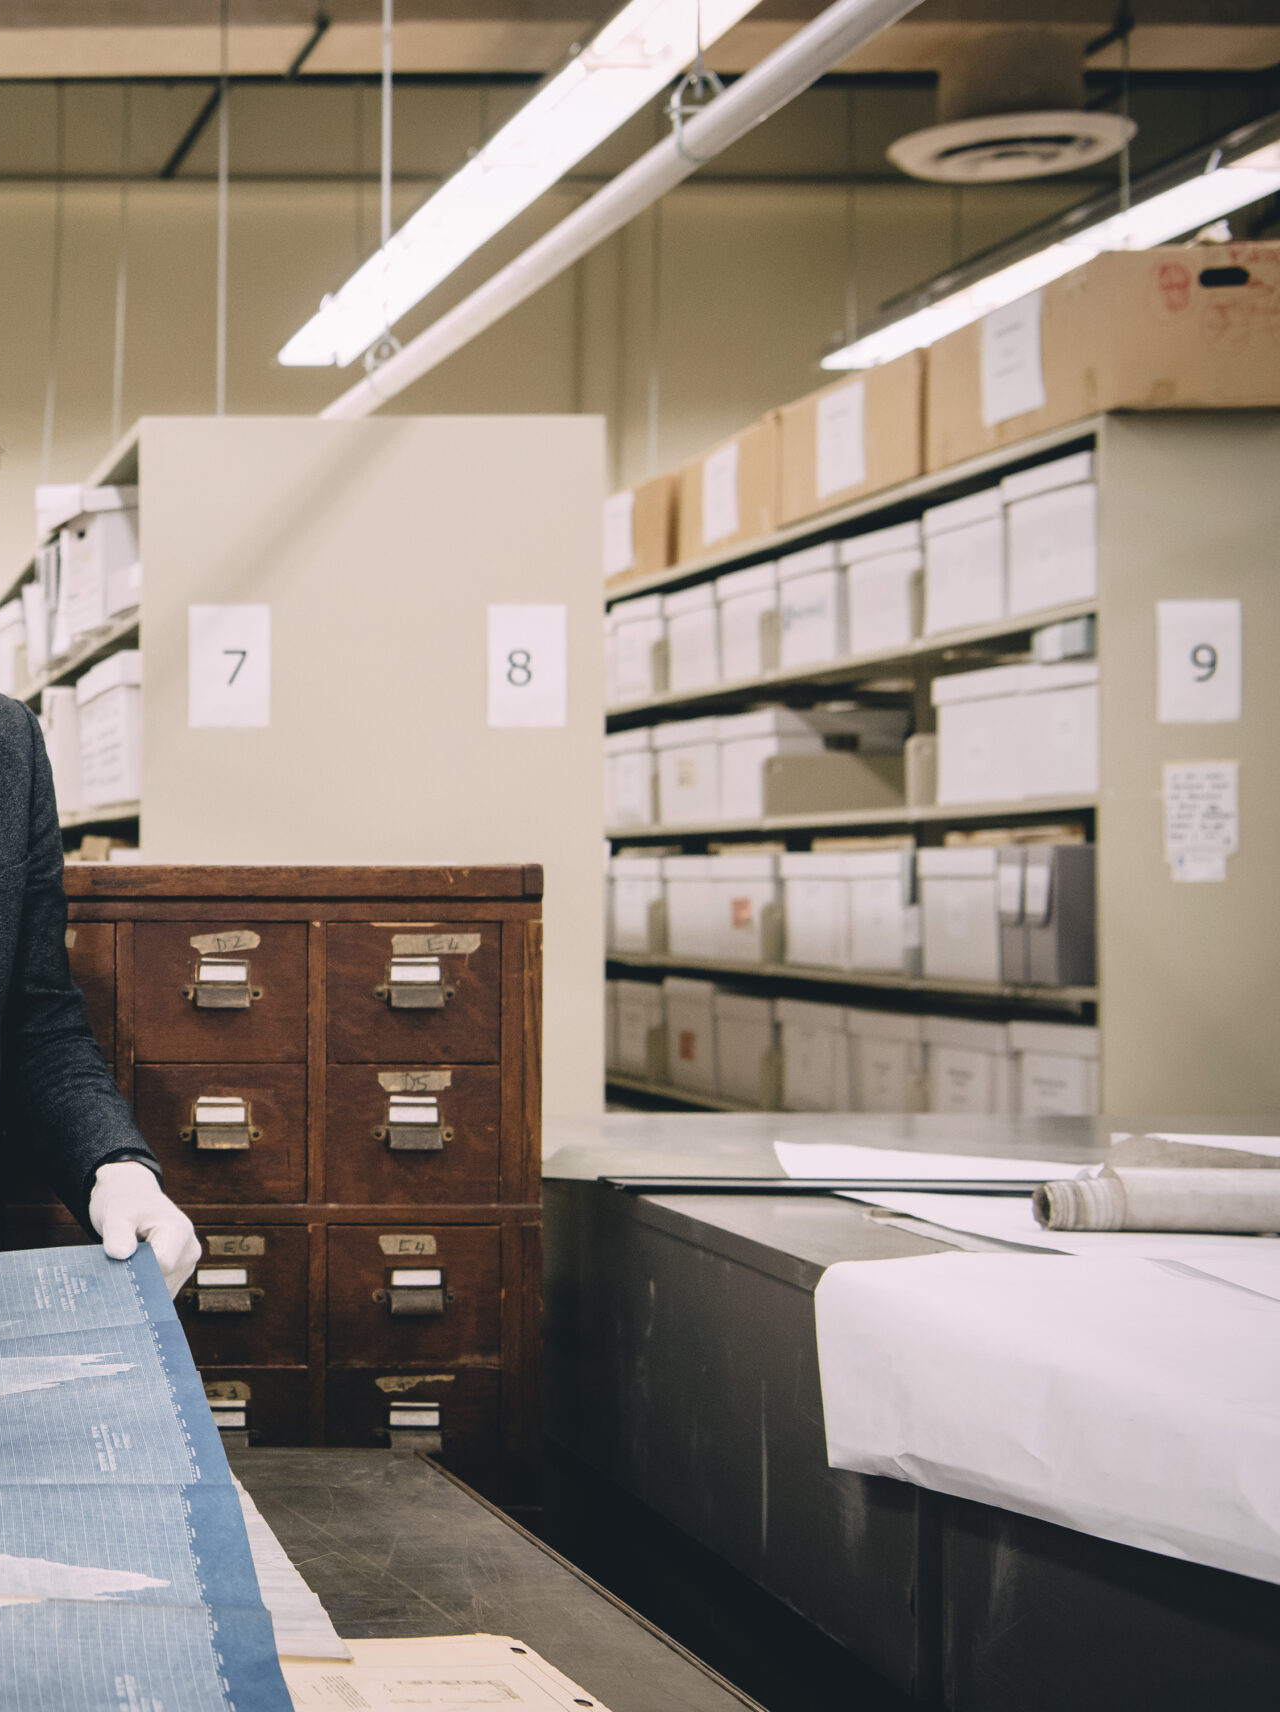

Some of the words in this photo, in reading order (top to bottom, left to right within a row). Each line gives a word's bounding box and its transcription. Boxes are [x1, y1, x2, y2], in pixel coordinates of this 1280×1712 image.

[222, 649, 247, 686] 7
[505, 648, 533, 687] 8
[1191, 643, 1217, 683] 9
